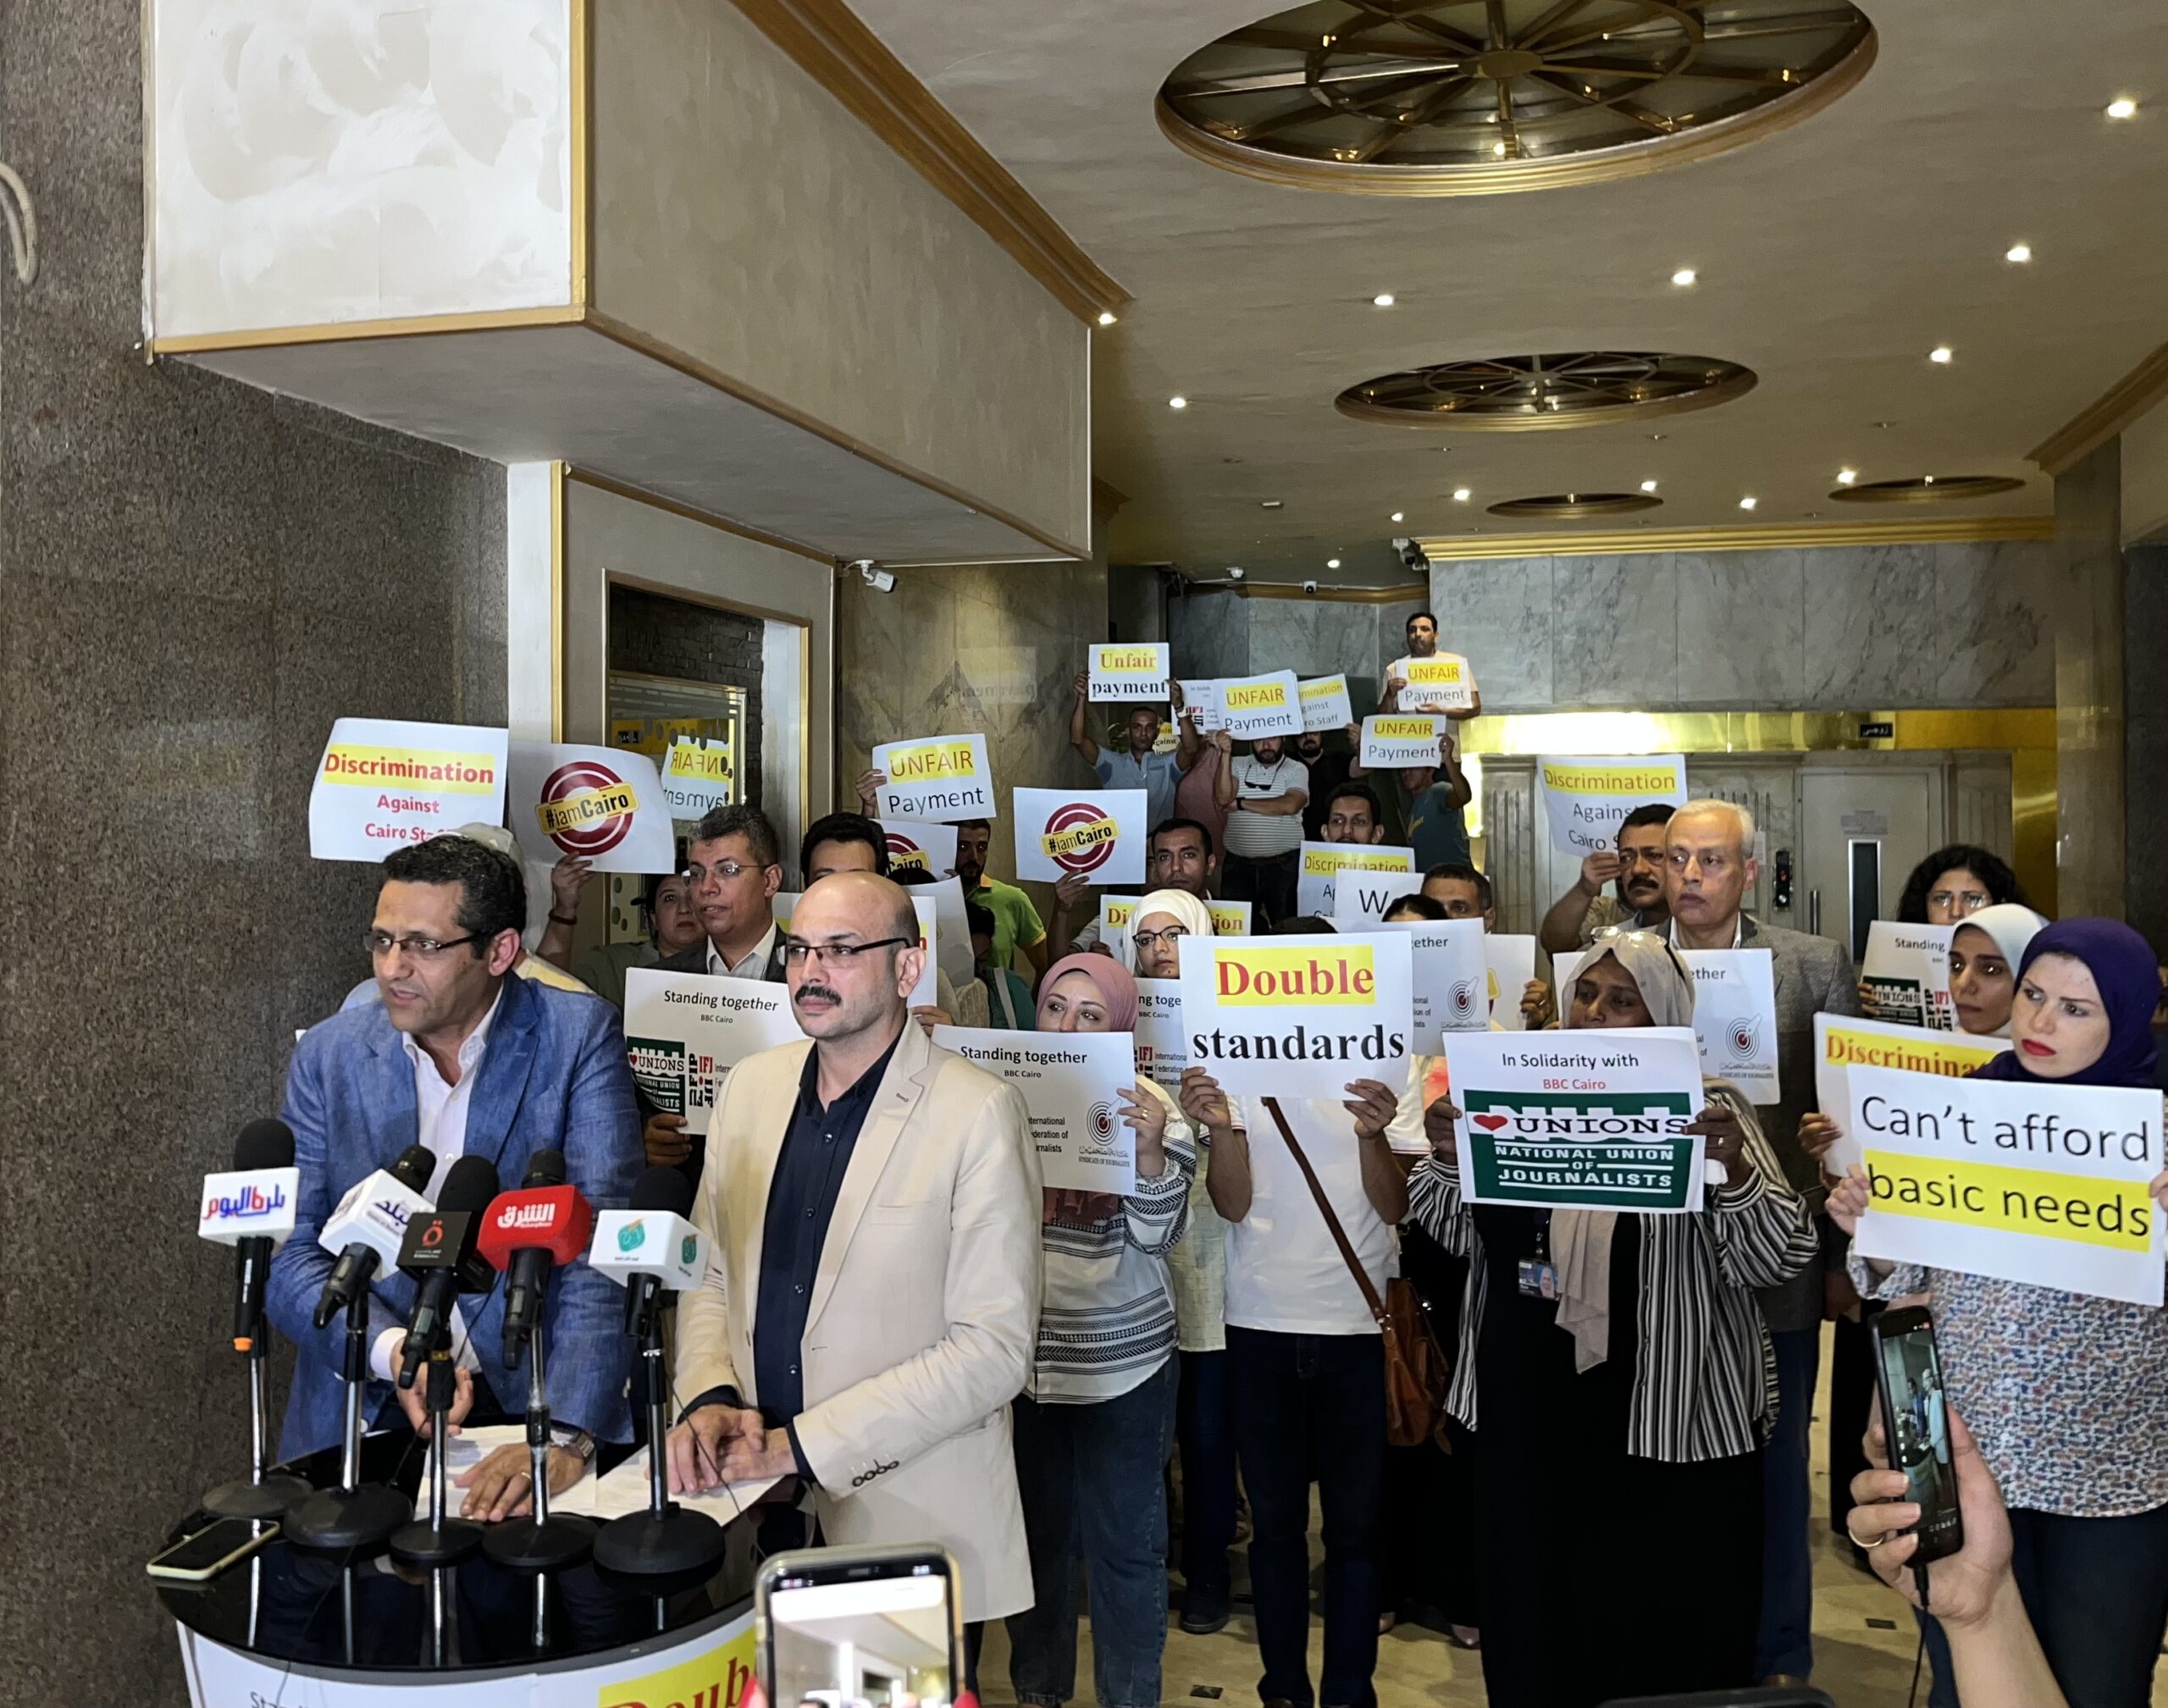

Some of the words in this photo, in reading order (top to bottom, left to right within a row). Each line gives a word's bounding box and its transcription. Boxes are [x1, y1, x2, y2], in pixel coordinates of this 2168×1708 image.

[1100, 653, 1157, 668] Unfair
[1408, 667, 1459, 680] UNFAIR
[1092, 679, 1166, 698] payment
[1226, 688, 1285, 705] UNFAIR
[1300, 684, 1342, 699] mination
[1405, 689, 1465, 703] Payment
[1302, 702, 1329, 713] gainst
[1225, 713, 1292, 732] Payment
[1374, 723, 1433, 735] UNFAIR
[1369, 745, 1436, 761] Payment
[324, 753, 495, 784] Discrimination
[890, 750, 973, 777] UNFAIR
[1543, 769, 1676, 790] Discrimination
[377, 794, 440, 814] Against
[888, 787, 985, 815] Payment
[545, 793, 629, 829] #iamCairo
[1573, 803, 1638, 823] Agains
[365, 823, 406, 840] Cairo
[1048, 826, 1112, 853] #iamCairo
[1568, 830, 1607, 850] Cairo
[1412, 937, 1448, 949] ether
[1895, 937, 1945, 953] Standing
[1215, 959, 1374, 996] Double
[1691, 967, 1726, 980] ther
[664, 991, 718, 1009] Standing
[722, 996, 779, 1012] together
[1156, 995, 1181, 1007] toge
[716, 1015, 733, 1024] Cairo
[1192, 1025, 1404, 1060] standards
[960, 1046, 1021, 1063] Standing
[1025, 1051, 1087, 1065] together
[1139, 1047, 1153, 1061] IFJ
[1502, 1053, 1516, 1067] In
[1521, 1053, 1596, 1070] Solidarity
[1601, 1053, 1640, 1067] with
[1827, 1035, 1982, 1077] Discrimina
[639, 1056, 684, 1072] UNIONS
[700, 1056, 713, 1074] IFJ
[1004, 1070, 1020, 1078] BBC
[1021, 1070, 1042, 1079] Cairo
[1543, 1078, 1568, 1090] BBC
[1572, 1078, 1606, 1091] Cairo
[1513, 1117, 1688, 1134] UNIONS
[1862, 1097, 1977, 1145] Can't
[1995, 1114, 2149, 1162] afford
[1061, 1130, 1069, 1139] of
[1495, 1146, 1596, 1158] NATIONAL
[1607, 1149, 1673, 1161] UNION
[1573, 1162, 1594, 1170] OF
[1498, 1169, 1673, 1186] JOURNALISTS
[1868, 1164, 1985, 1213] basic
[2004, 1190, 2149, 1237] needs
[497, 1202, 555, 1228] الشرق
